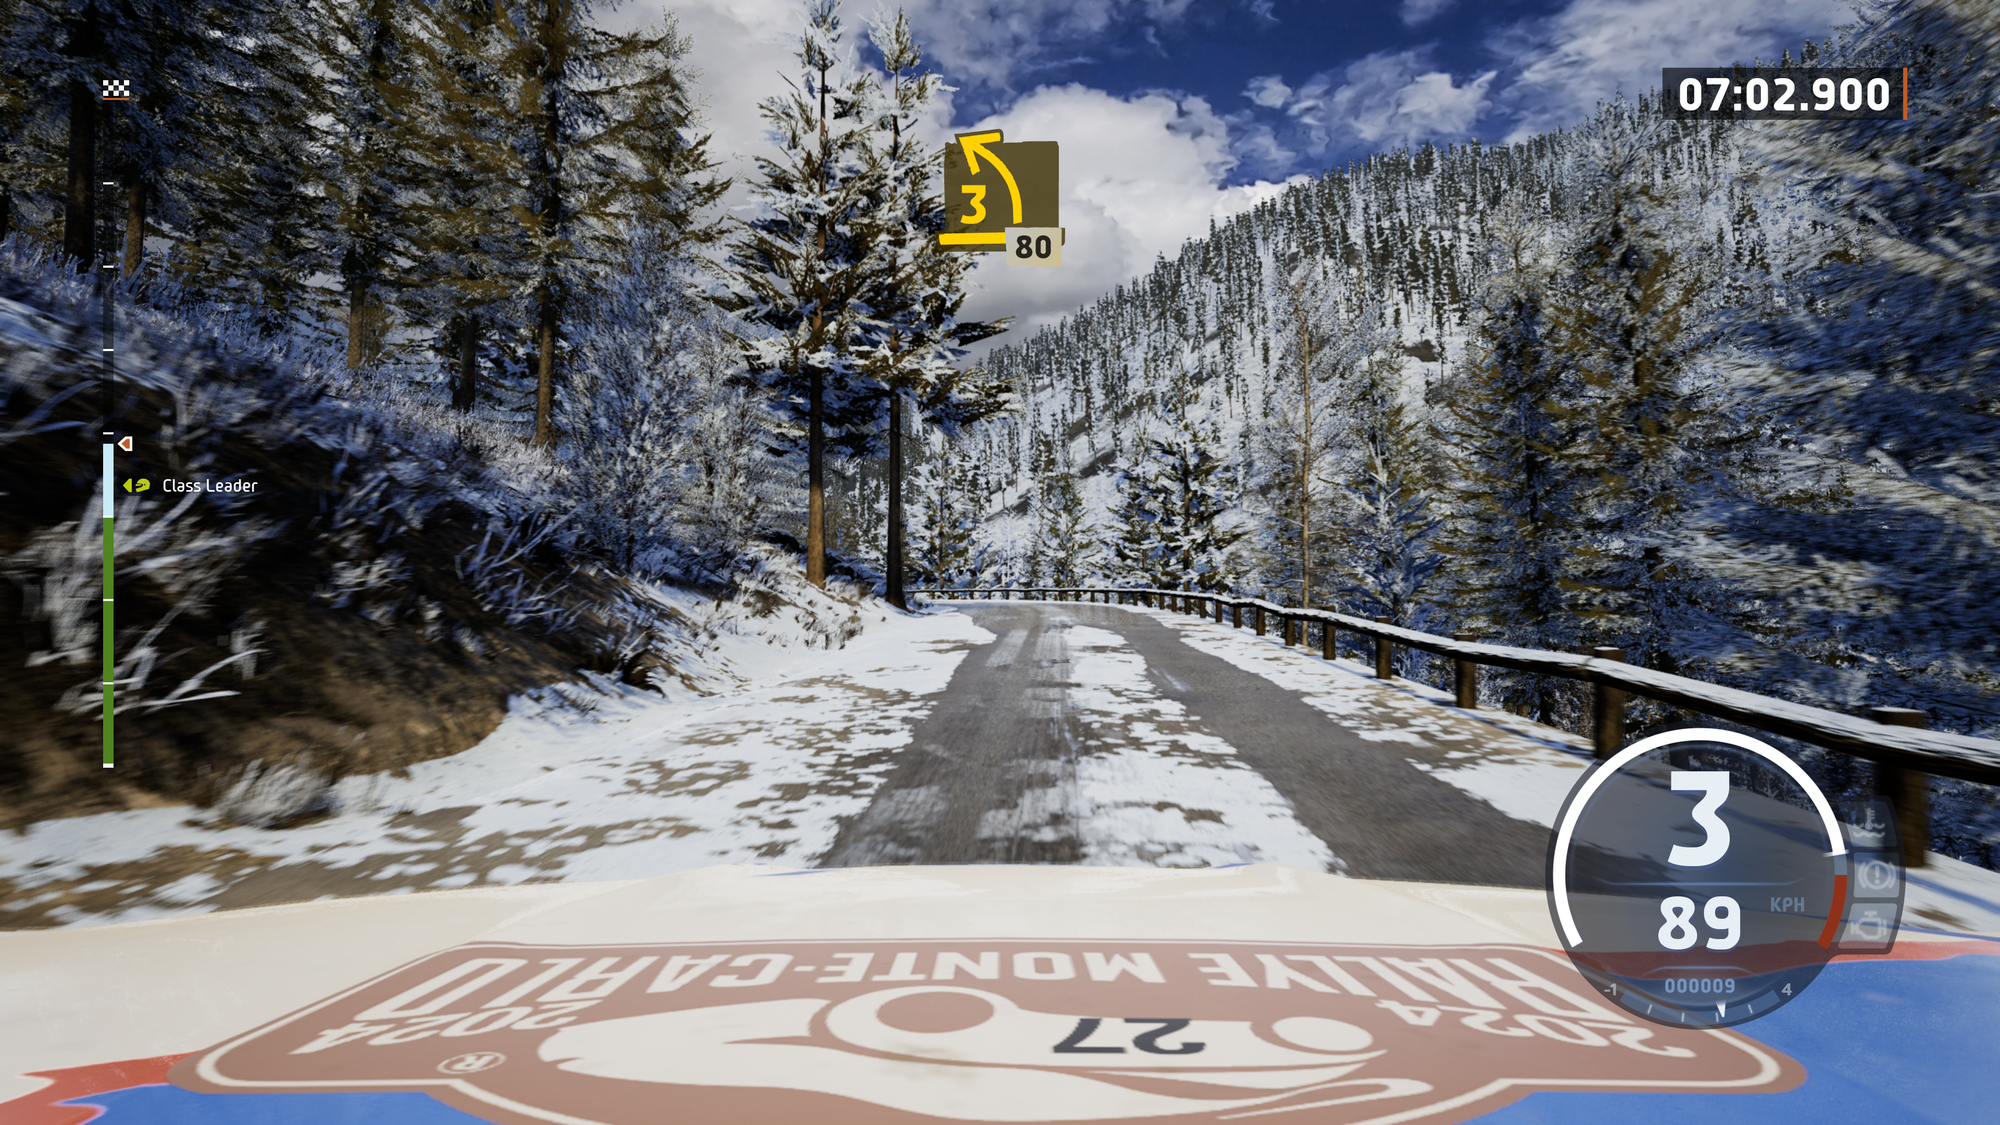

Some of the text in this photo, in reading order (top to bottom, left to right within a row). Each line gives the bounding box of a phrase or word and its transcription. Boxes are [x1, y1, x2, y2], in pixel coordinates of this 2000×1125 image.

[353, 951, 1635, 1024] RALLYE MONTE-CARLO
[288, 1000, 604, 1055] 2024
[1052, 1018, 1206, 1054] 27
[1374, 999, 1697, 1058] 2024
